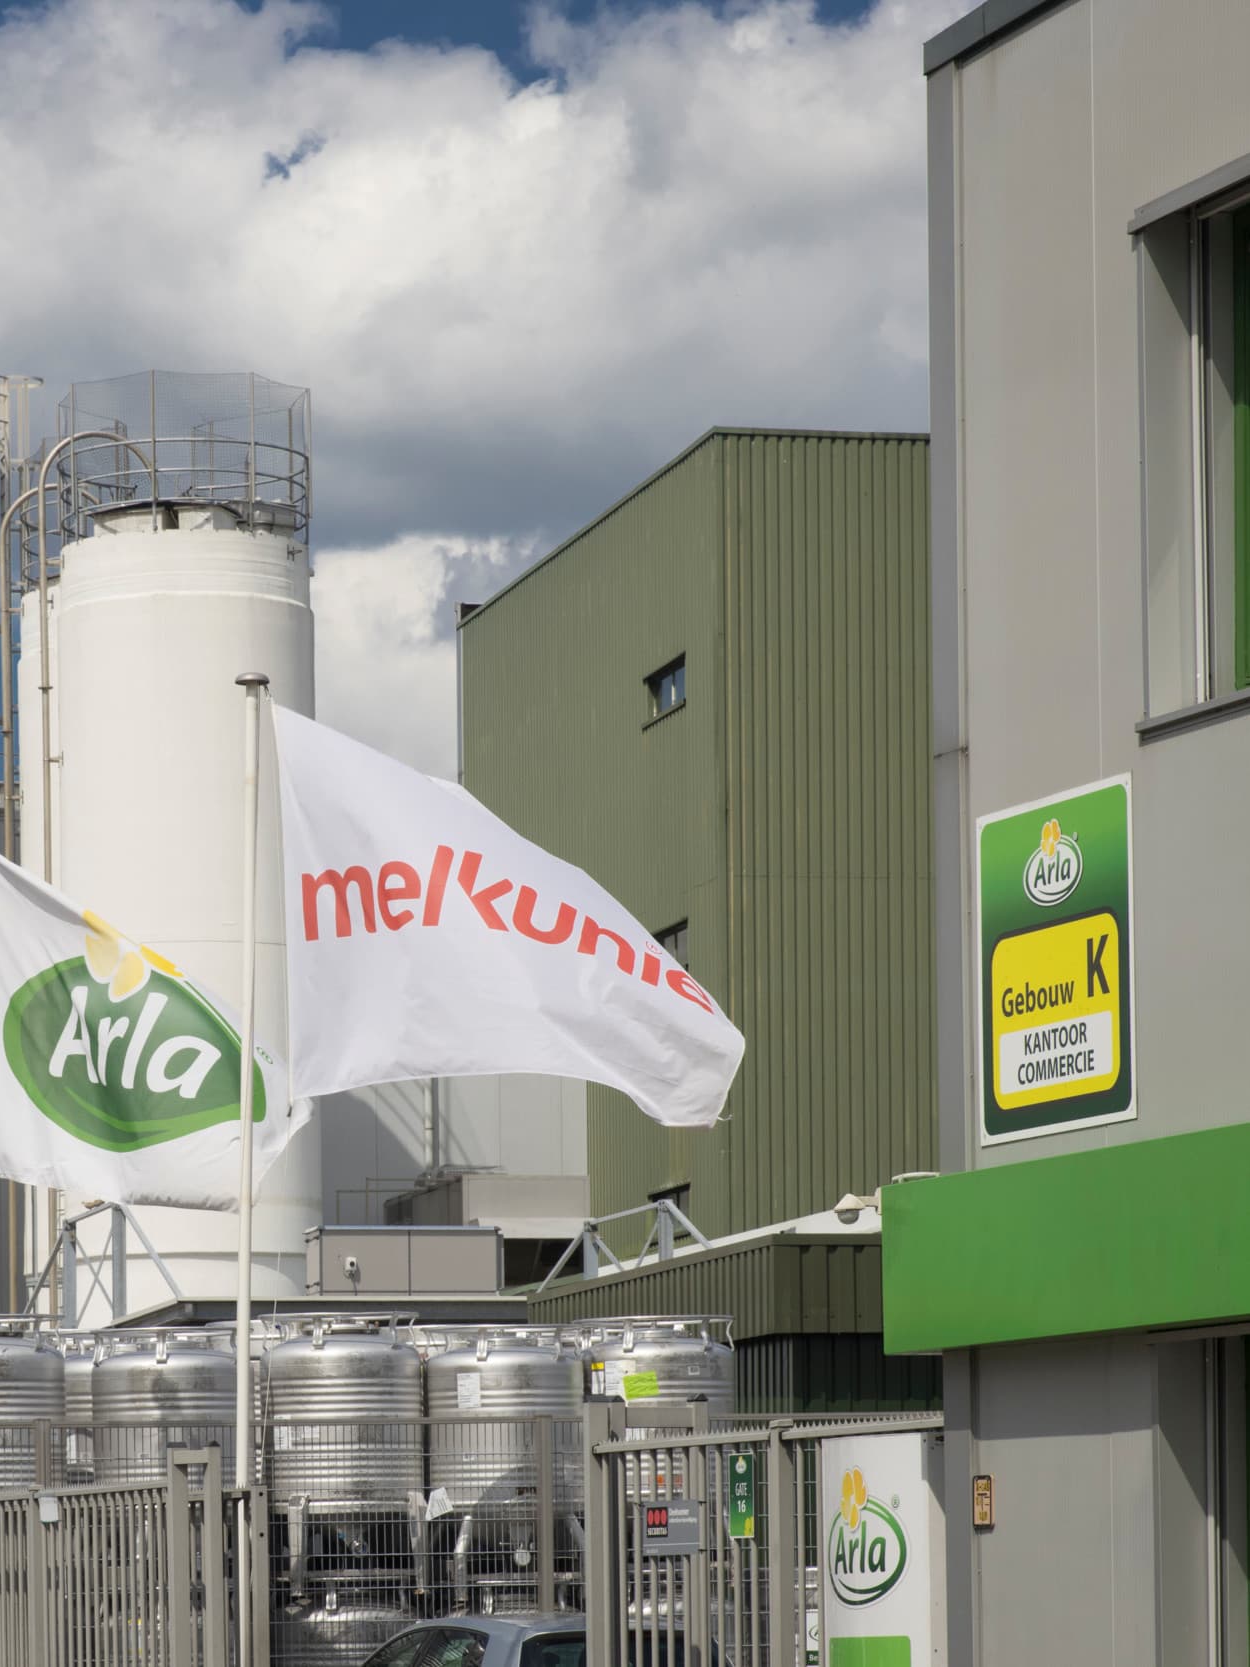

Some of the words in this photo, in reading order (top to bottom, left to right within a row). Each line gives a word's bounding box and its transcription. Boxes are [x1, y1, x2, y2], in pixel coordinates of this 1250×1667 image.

[1034, 850, 1071, 888] Arla
[302, 845, 715, 1015] melkunie
[1001, 980, 1075, 1017] Gebouw
[1086, 933, 1111, 998] K
[49, 985, 222, 1099] Arla
[1024, 1022, 1087, 1056] KANTOOR
[1017, 1049, 1095, 1085] COMMERCIE
[735, 1482, 748, 1496] GATE
[737, 1500, 747, 1513] 16
[834, 1520, 886, 1575] Arla
